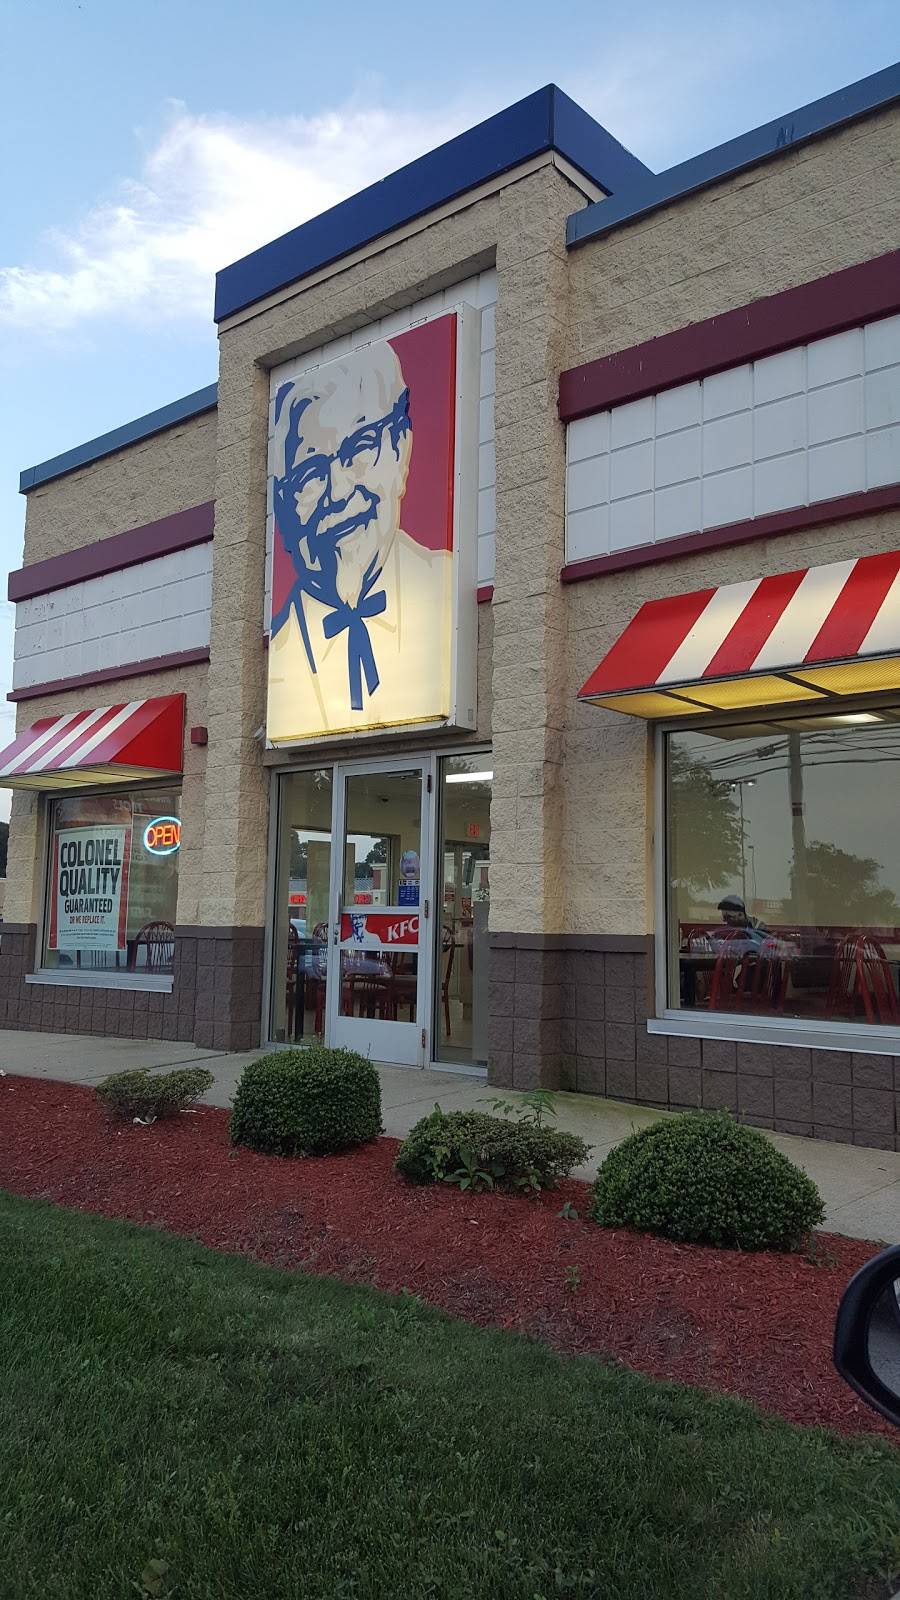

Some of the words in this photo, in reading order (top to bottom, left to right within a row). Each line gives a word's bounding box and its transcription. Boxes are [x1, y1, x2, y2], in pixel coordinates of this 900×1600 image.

[146, 825, 180, 847] OPEN
[60, 839, 121, 868] COLONEL
[59, 868, 120, 897] QUALITY
[64, 898, 113, 914] GUARANTEED
[69, 915, 75, 924] OR
[76, 915, 81, 924] WE
[82, 915, 99, 924] REPLACE
[387, 916, 419, 942] KFC
